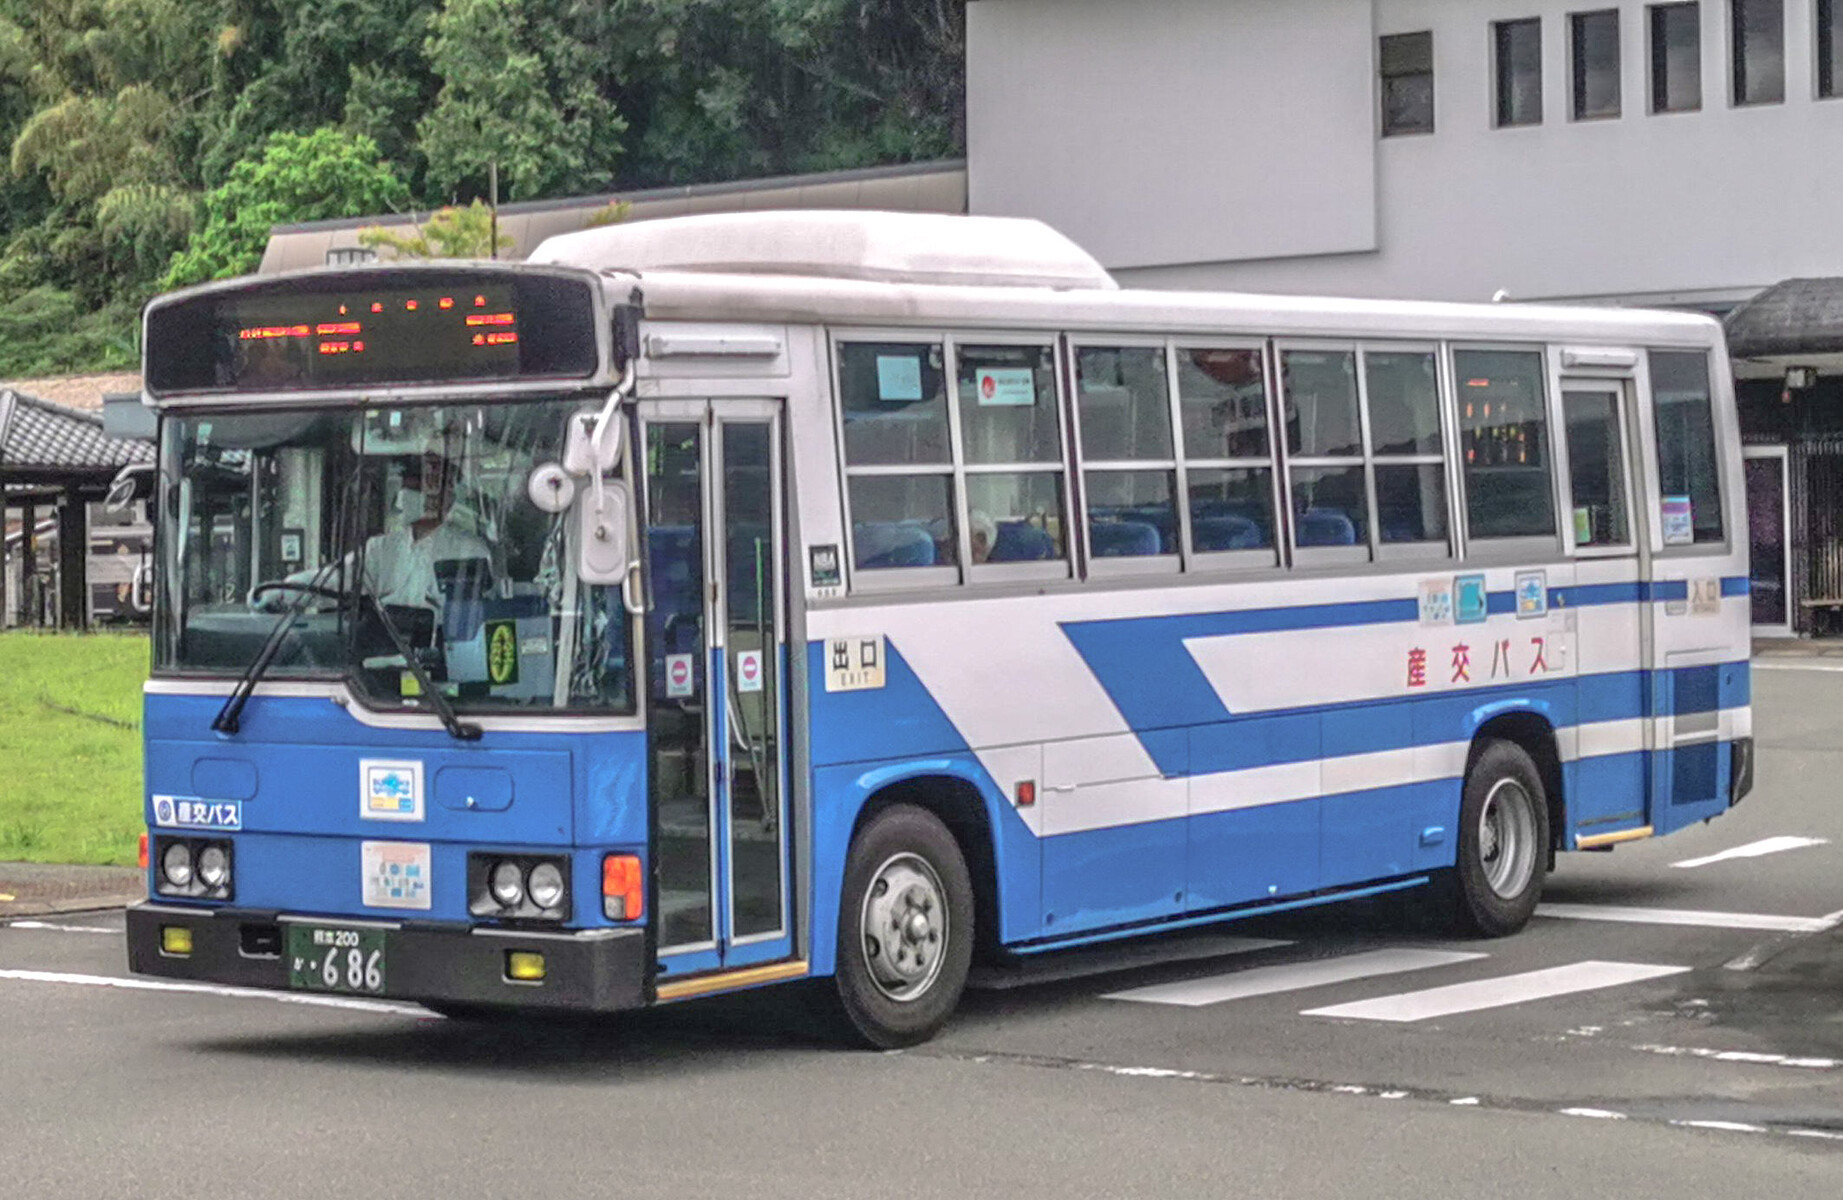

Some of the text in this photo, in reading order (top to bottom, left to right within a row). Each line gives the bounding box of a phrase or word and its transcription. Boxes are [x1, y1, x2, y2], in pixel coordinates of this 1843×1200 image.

[833, 639, 877, 671] 出口
[1407, 637, 1548, 688] 産交バス
[335, 930, 359, 947] 200
